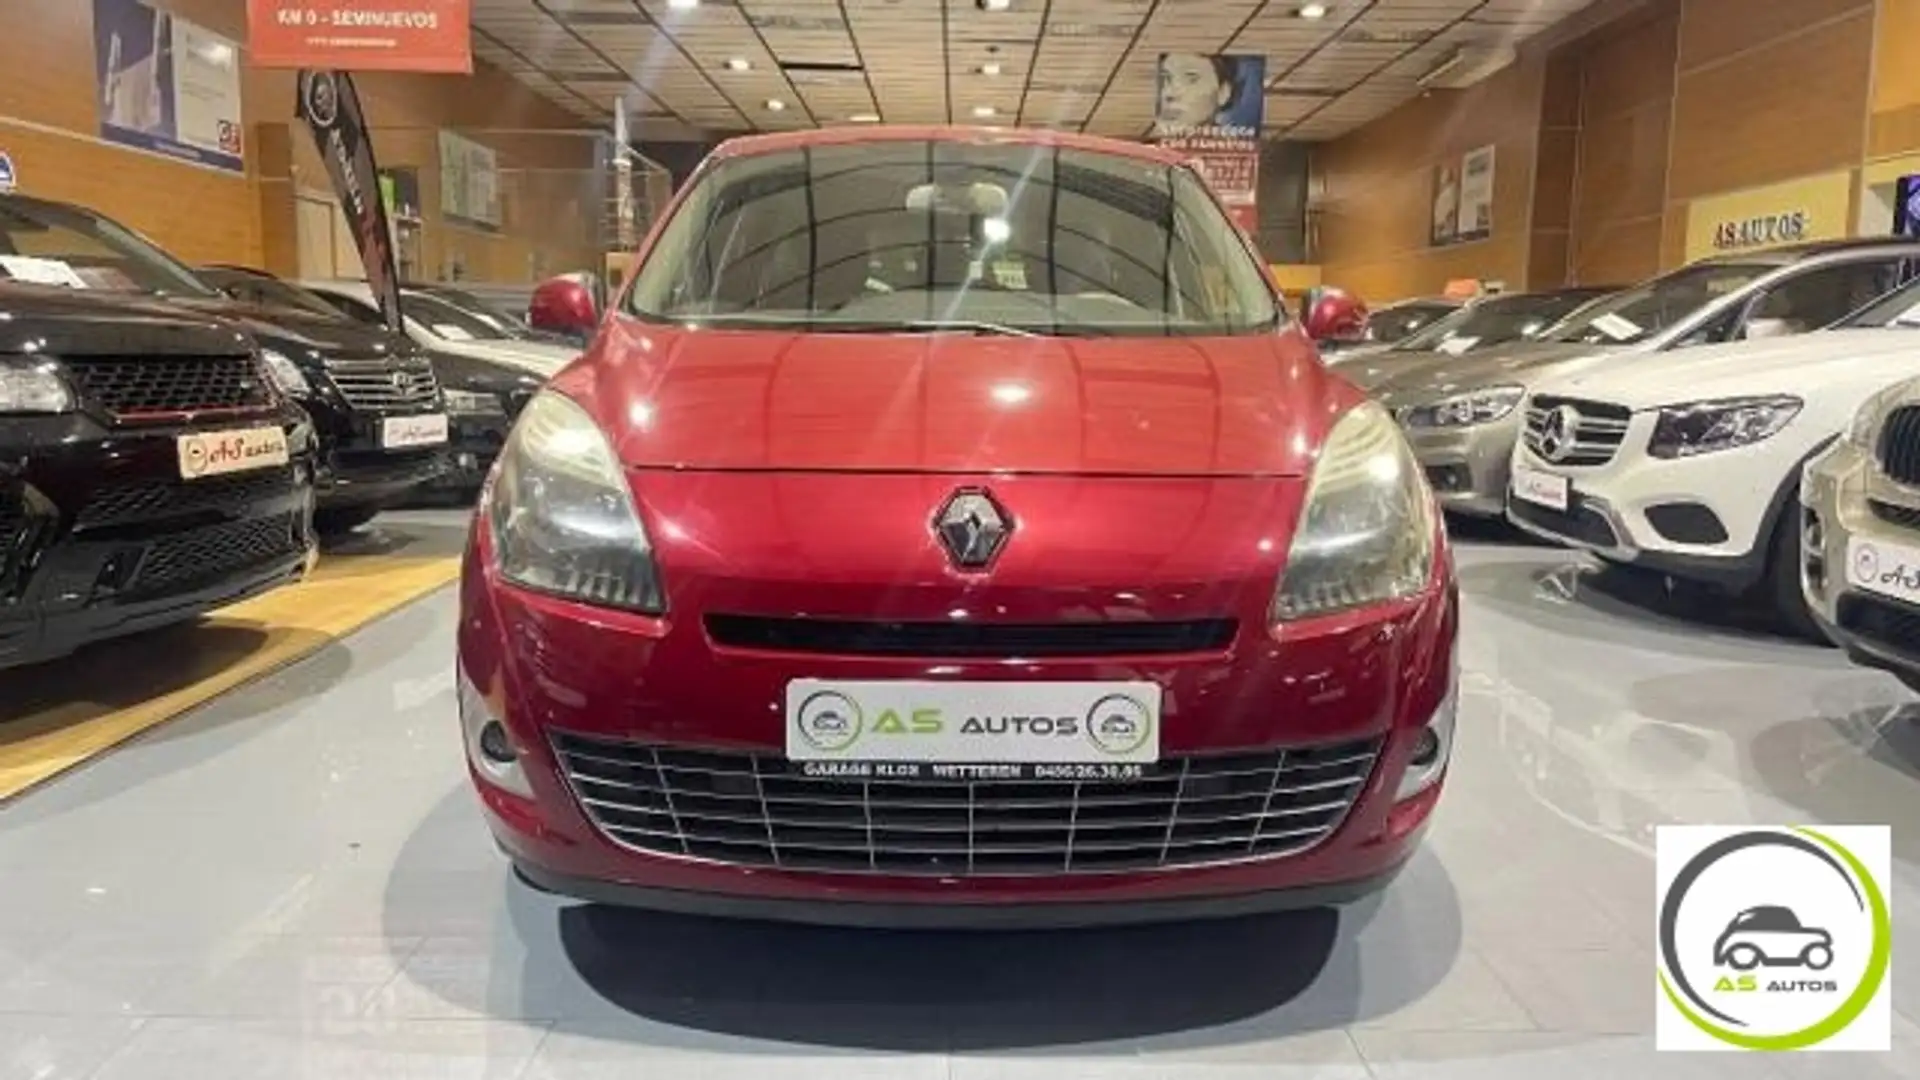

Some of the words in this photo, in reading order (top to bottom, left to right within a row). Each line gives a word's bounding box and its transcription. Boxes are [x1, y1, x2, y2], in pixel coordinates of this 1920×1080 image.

[277, 9, 302, 25] KM
[333, 9, 438, 29] SEMINUEVOS
[872, 708, 943, 734] AS
[959, 716, 1078, 735] AUTOS
[804, 762, 871, 776] GARAGE
[932, 764, 1021, 778] WETTEREN
